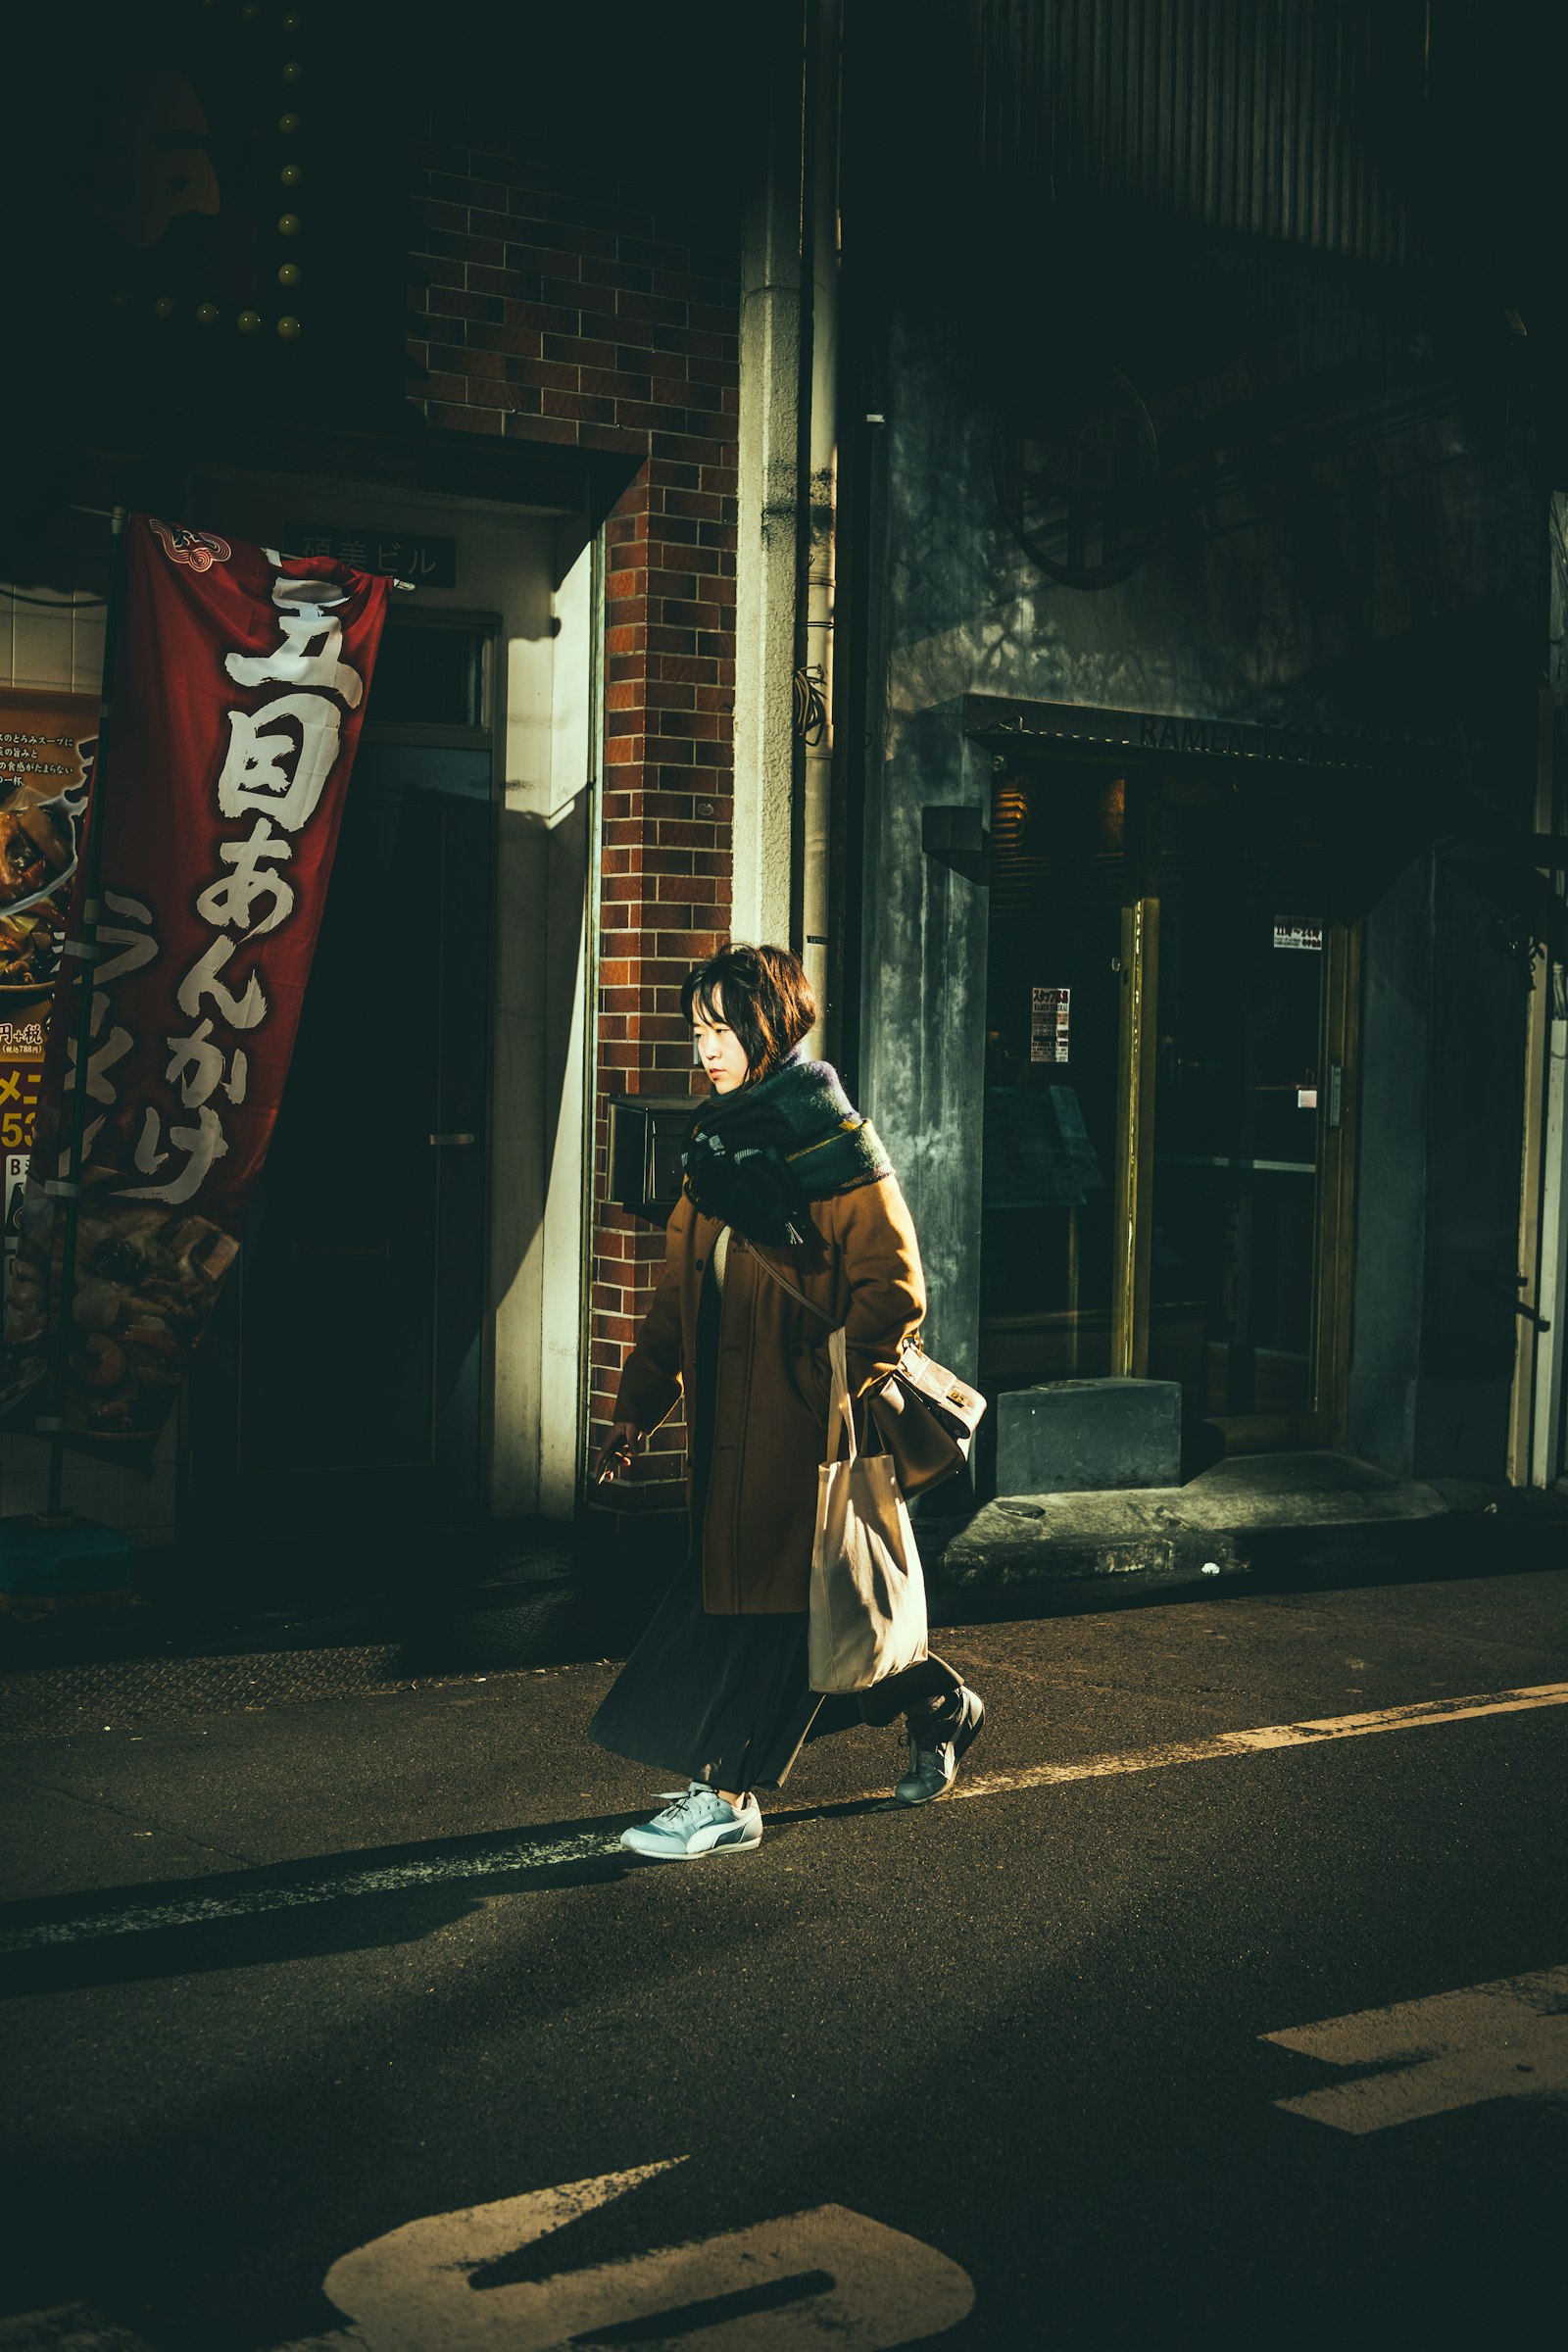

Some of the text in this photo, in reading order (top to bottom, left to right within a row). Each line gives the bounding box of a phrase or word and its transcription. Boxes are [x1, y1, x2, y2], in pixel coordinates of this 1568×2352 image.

[109, 576, 364, 1204] 五目あんかけ
[1140, 714, 1247, 755] RAMEN
